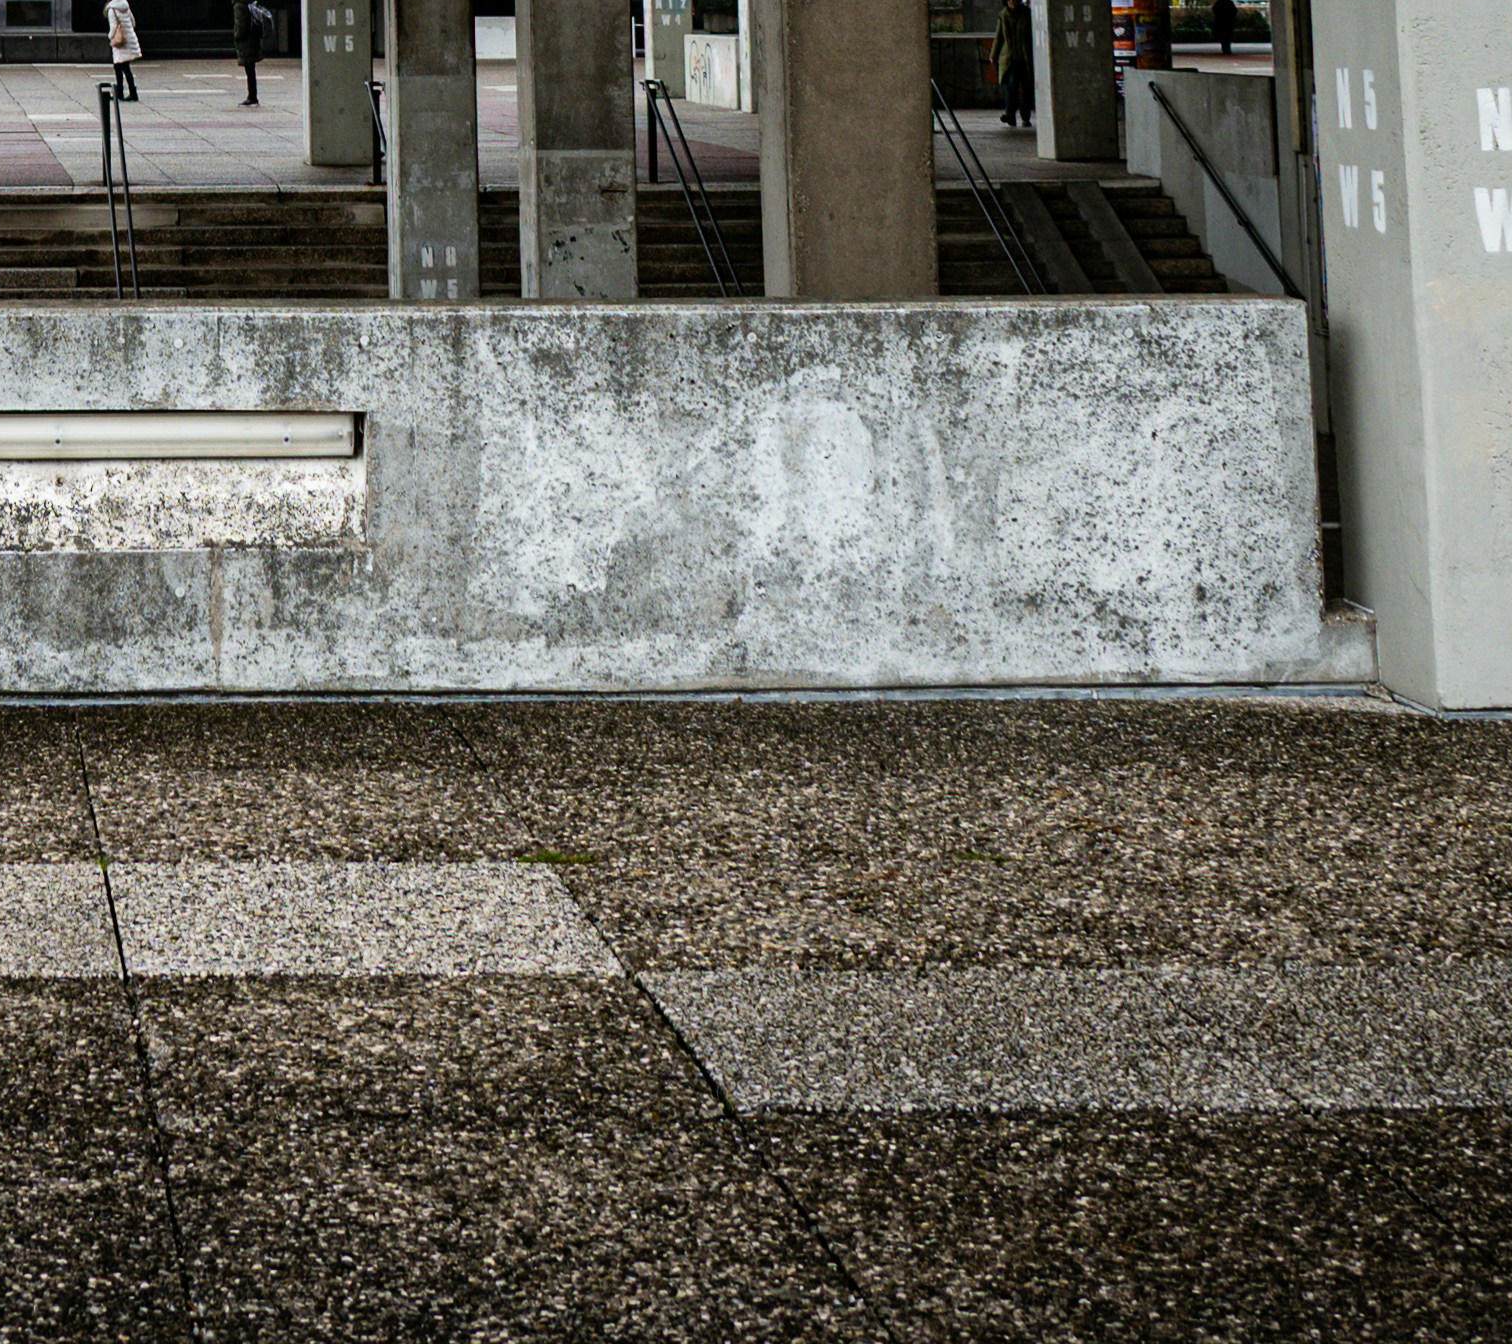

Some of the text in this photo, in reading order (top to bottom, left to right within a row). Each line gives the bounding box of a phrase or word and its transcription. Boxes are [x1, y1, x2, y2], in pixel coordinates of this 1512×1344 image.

[327, 9, 354, 26] N 9
[324, 35, 353, 52] W 5
[1336, 68, 1377, 130] N 5
[1339, 164, 1386, 233] W 5
[422, 246, 456, 267] N 8
[421, 279, 457, 299] W 5
